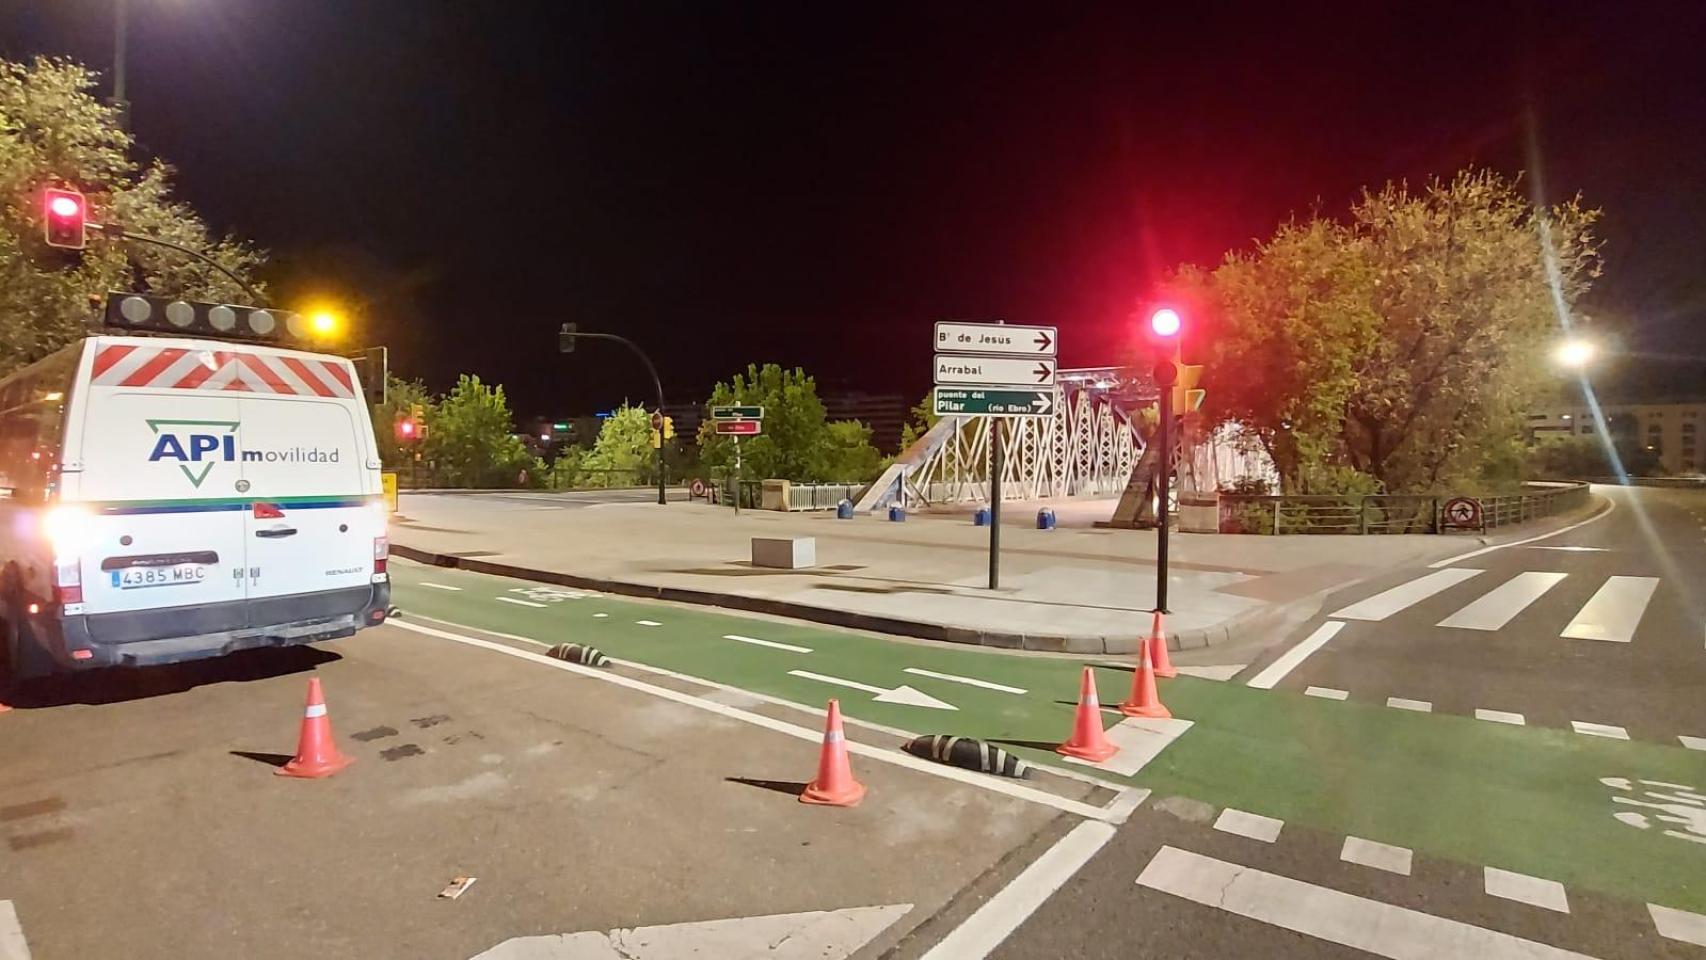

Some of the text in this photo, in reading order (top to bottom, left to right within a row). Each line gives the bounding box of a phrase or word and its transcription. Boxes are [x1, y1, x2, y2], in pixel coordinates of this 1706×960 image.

[958, 333, 971, 342] de
[939, 364, 982, 374] Arrabal
[938, 400, 965, 410] Pilar
[1008, 404, 1031, 413] Ebro)
[148, 434, 339, 463] API movilidad
[123, 566, 205, 584] 4385 MBC
